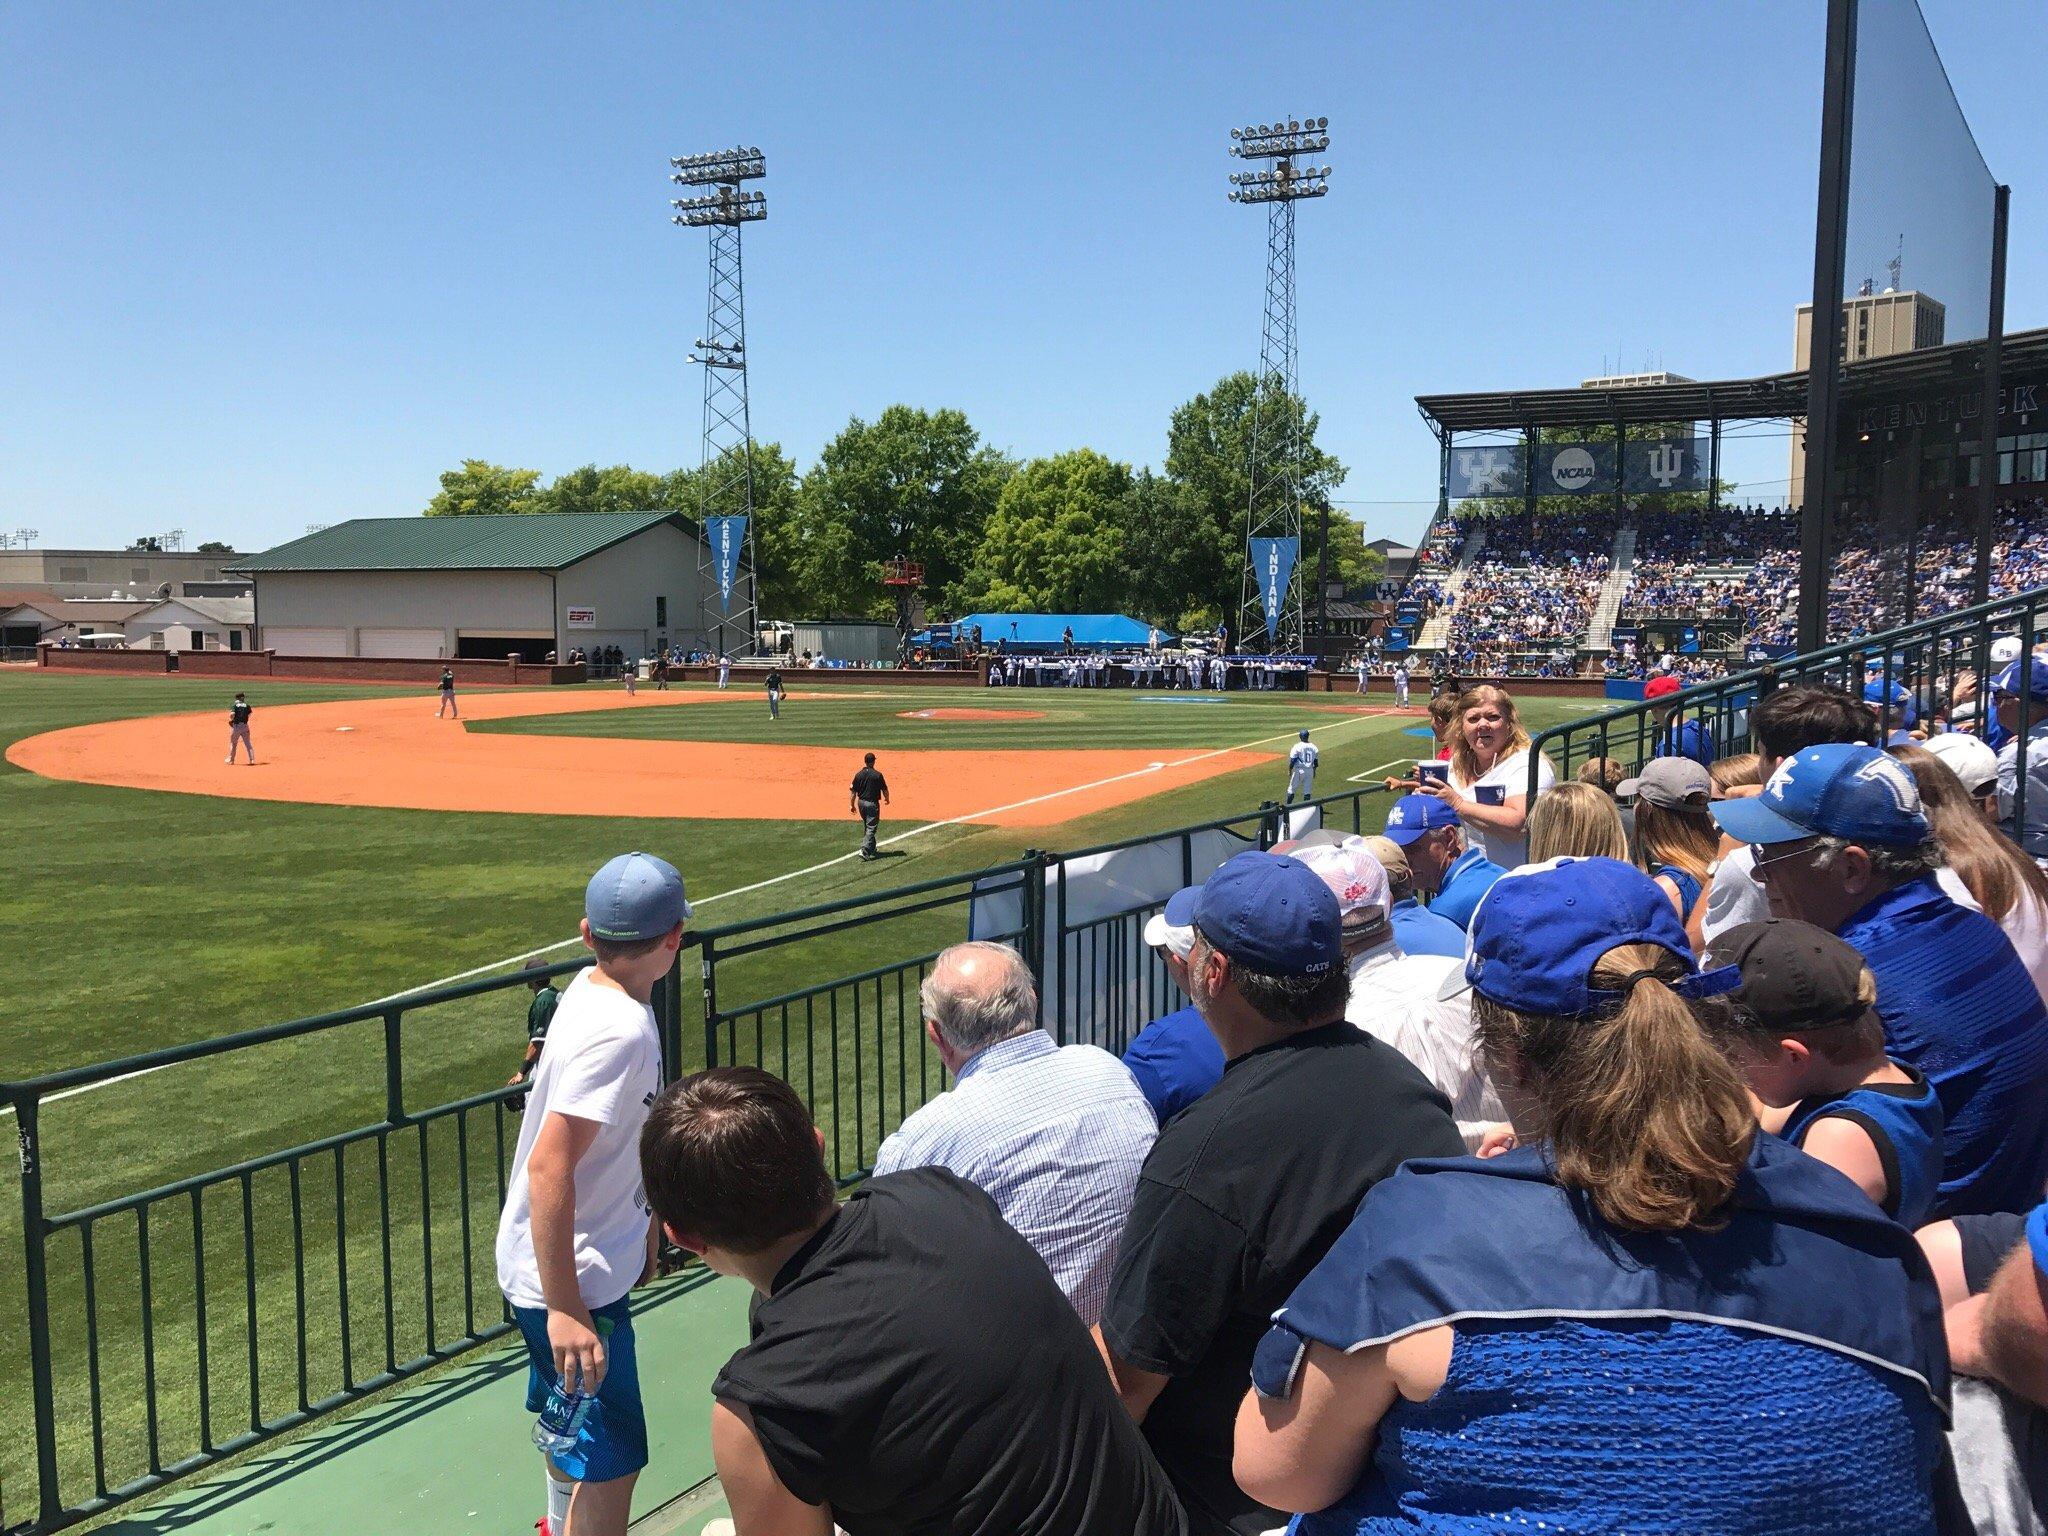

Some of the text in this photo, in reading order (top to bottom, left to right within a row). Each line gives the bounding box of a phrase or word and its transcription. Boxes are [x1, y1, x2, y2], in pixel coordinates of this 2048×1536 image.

[1555, 466, 1594, 480] NCAA
[721, 519, 730, 600] KENTUCKY
[1267, 543, 1279, 618] INDIANA
[569, 611, 594, 621] ESPN
[1305, 960, 1330, 973] CATS
